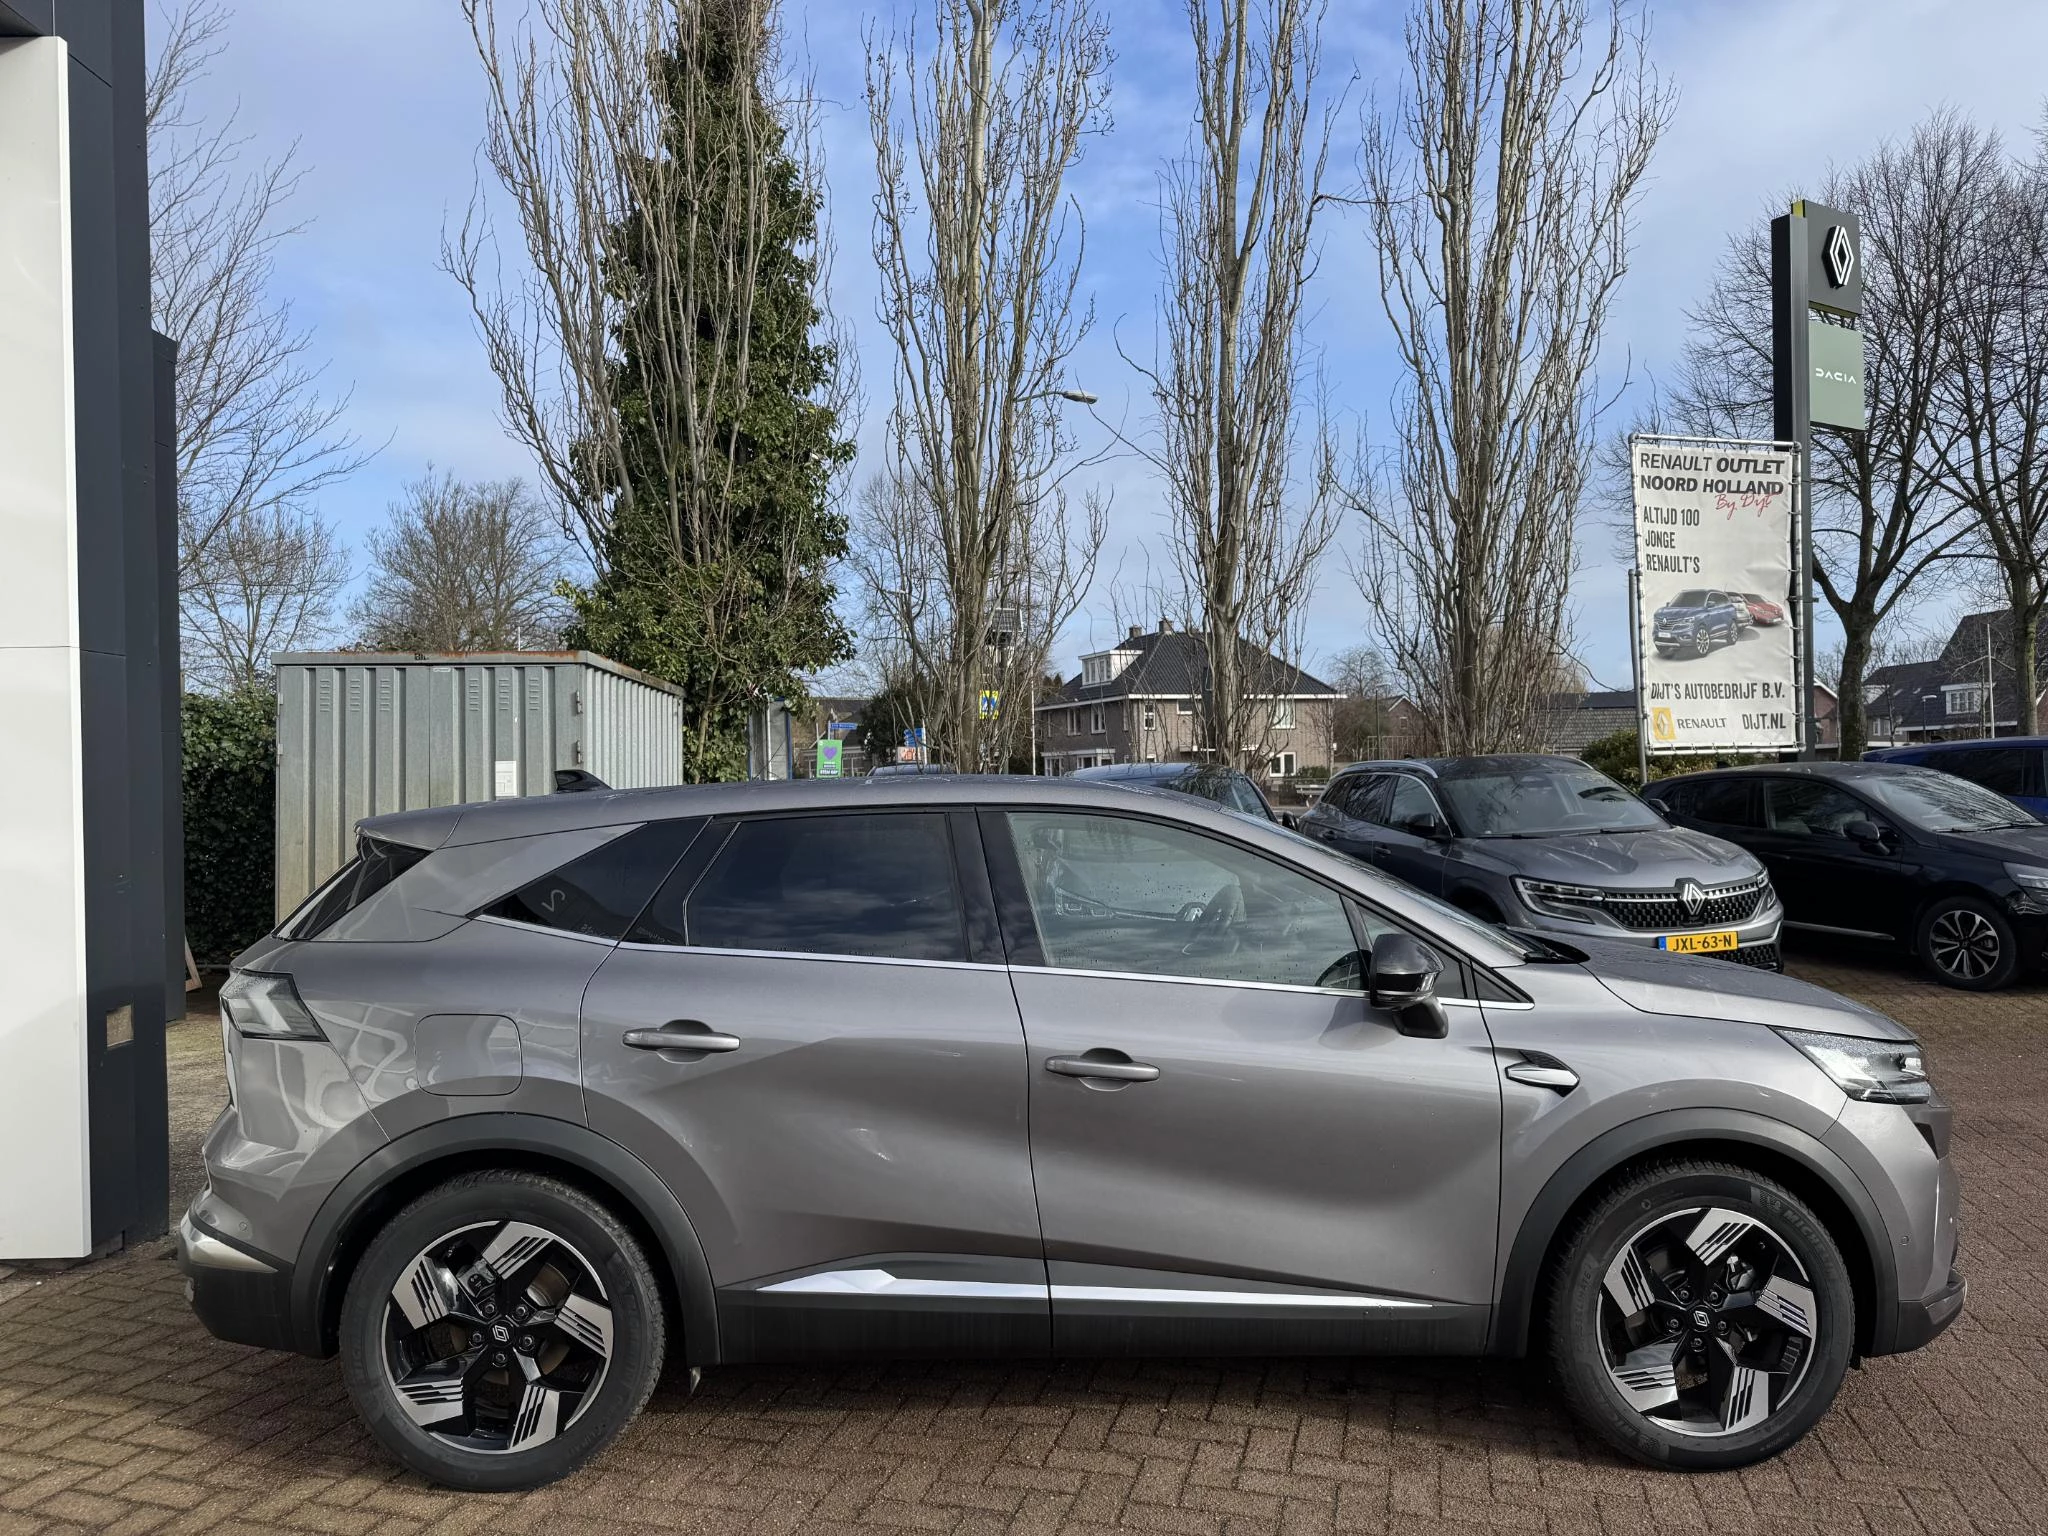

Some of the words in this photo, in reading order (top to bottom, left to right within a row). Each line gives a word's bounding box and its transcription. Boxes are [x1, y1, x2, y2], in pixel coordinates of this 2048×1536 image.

[1815, 367, 1857, 385] DACIA
[1640, 453, 1712, 472] RENAULT
[1716, 457, 1785, 474] OUTLET
[1640, 474, 1698, 492] NOORD
[1702, 478, 1784, 495] HOLLAND
[1643, 505, 1677, 525] ALTIJD
[1680, 508, 1700, 526] 100
[1715, 493, 1737, 521] By
[1645, 529, 1676, 549] JONGE
[1646, 553, 1700, 574] RENAULT'S
[1650, 682, 1681, 700] DIJT'S
[1684, 682, 1758, 700] AUTOBEDRIJF
[1762, 682, 1785, 699] B.V.
[1676, 717, 1727, 729] RENAULT
[1742, 712, 1786, 730] DIJT.NL
[1672, 934, 1732, 951] JXL-63-N
